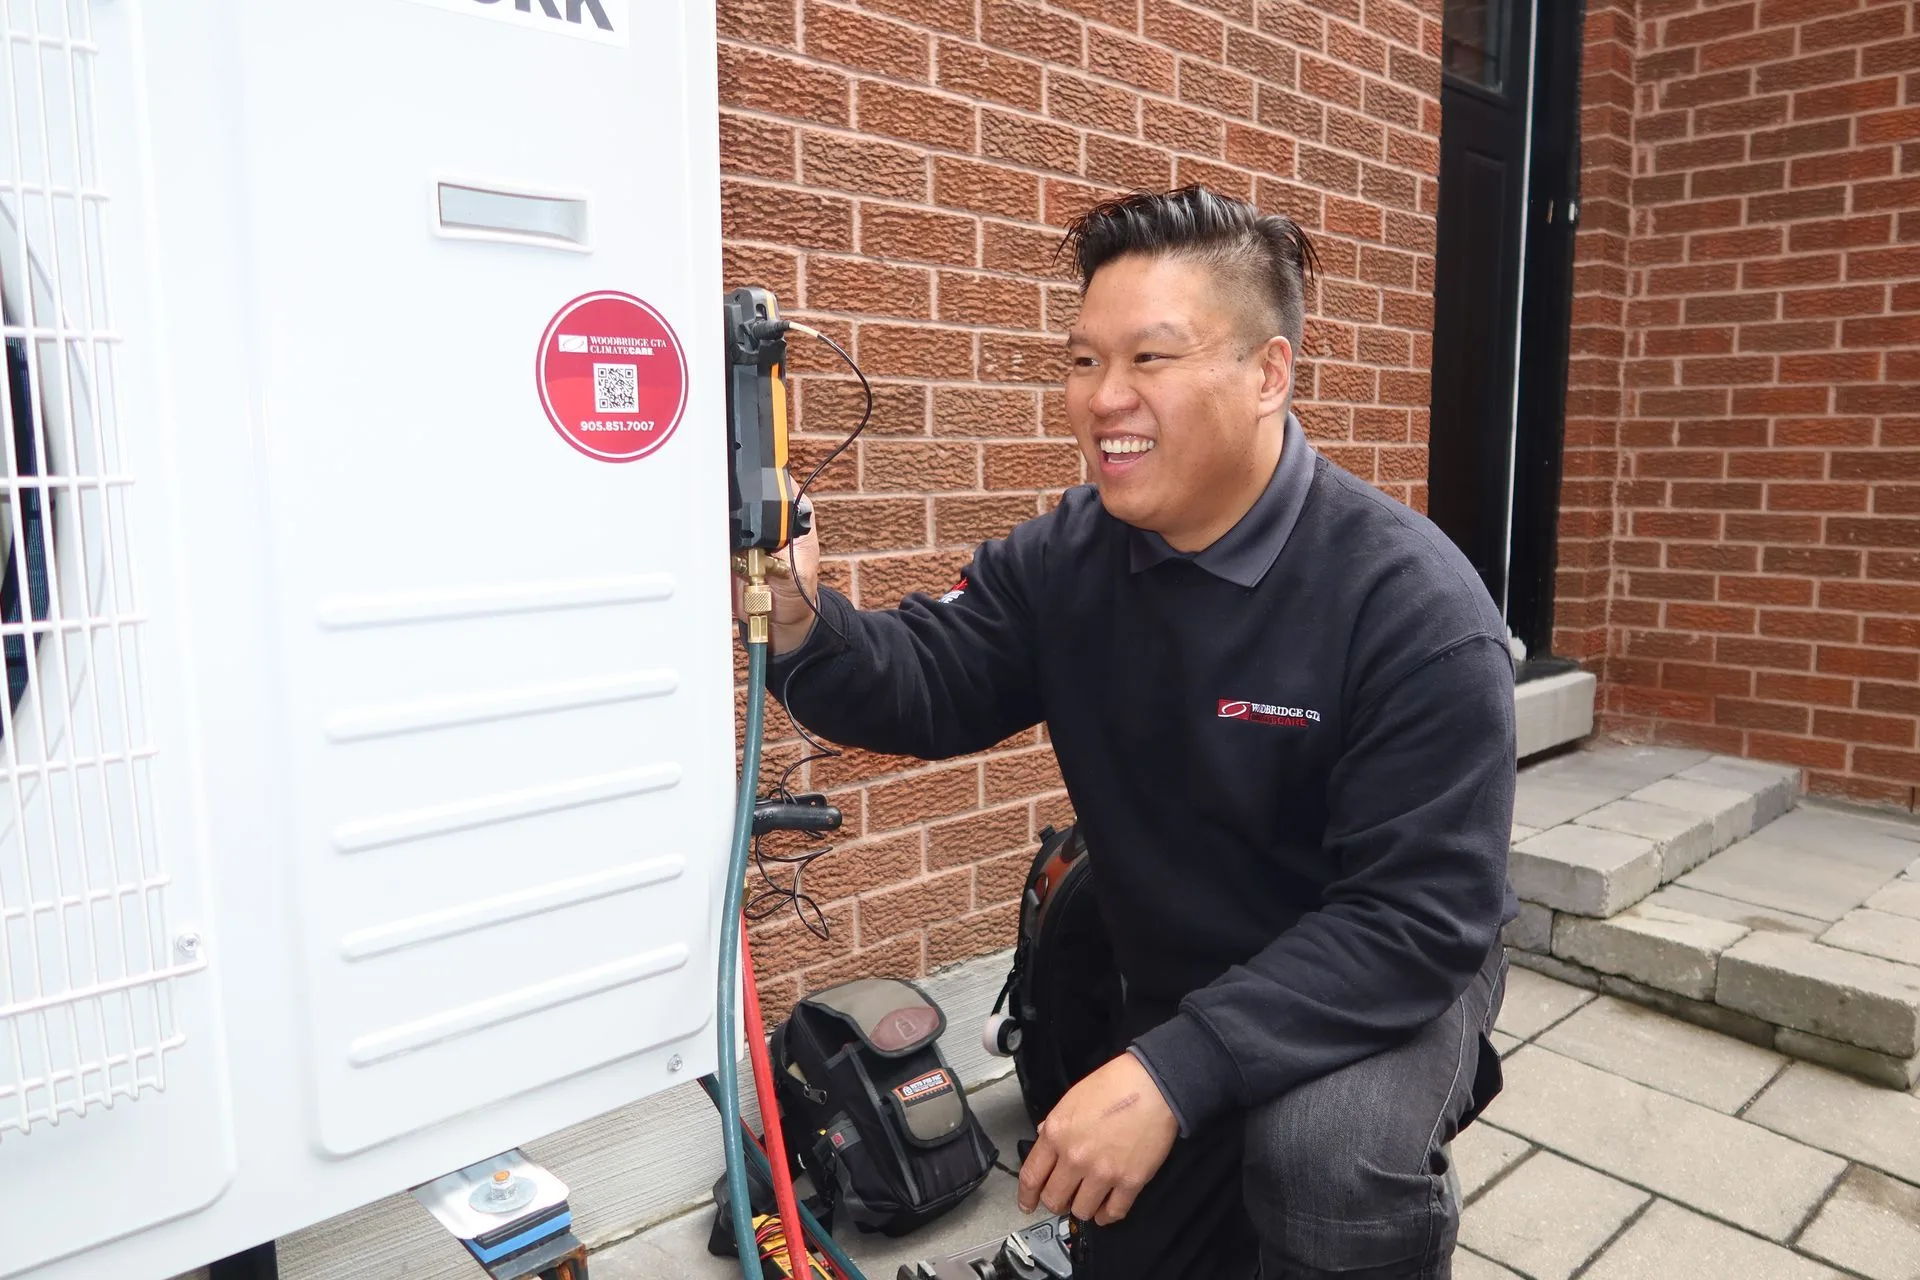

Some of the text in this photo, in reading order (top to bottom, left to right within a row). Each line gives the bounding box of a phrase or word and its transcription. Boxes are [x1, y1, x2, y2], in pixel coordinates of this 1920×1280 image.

[590, 336, 667, 348] WOODBRIDGE GTA
[590, 346, 653, 355] CLIMATECARE
[581, 421, 654, 431] 905.851.7007
[1252, 703, 1303, 717] WDBRIDGE
